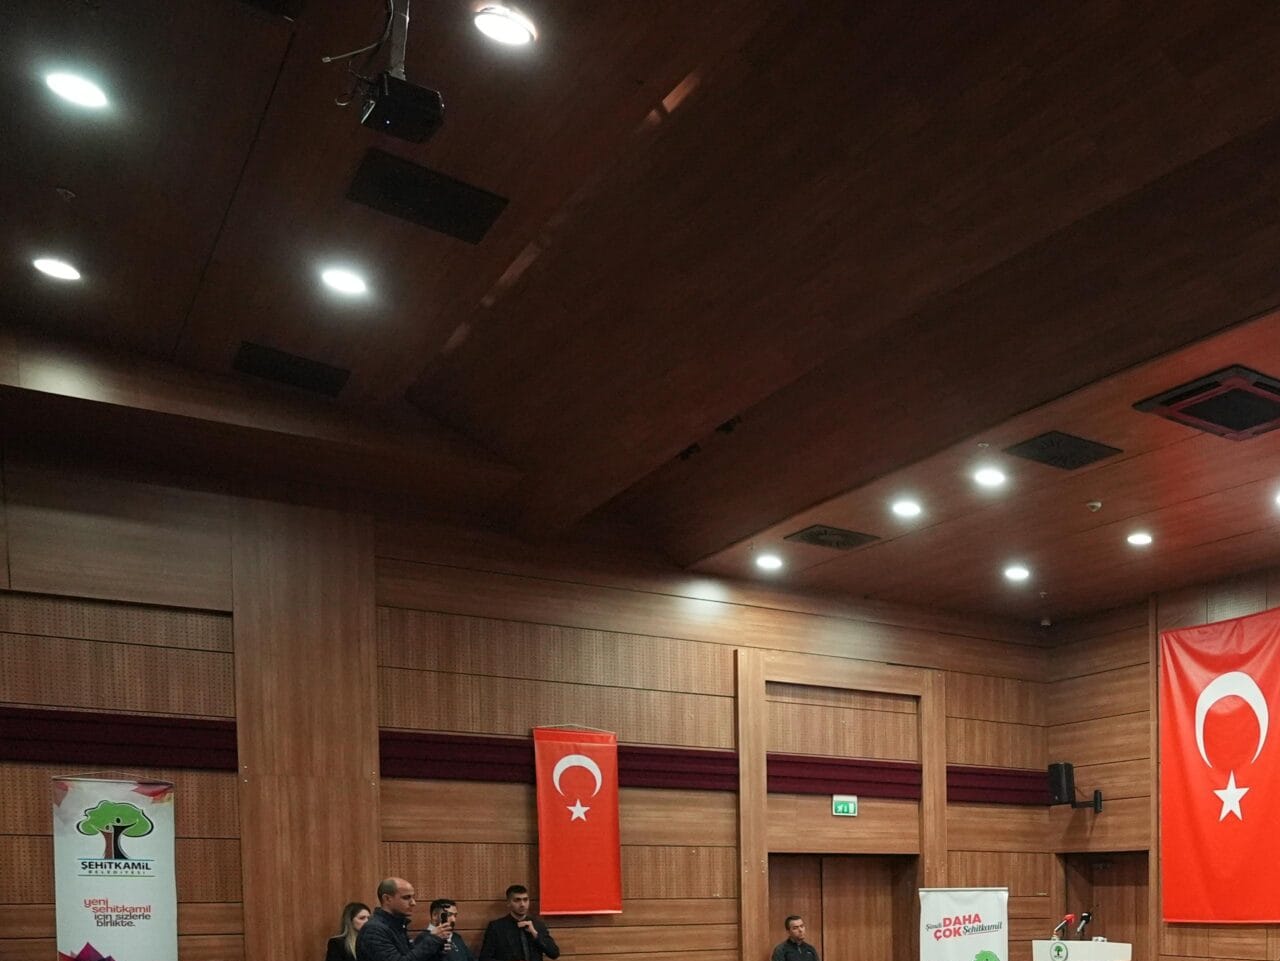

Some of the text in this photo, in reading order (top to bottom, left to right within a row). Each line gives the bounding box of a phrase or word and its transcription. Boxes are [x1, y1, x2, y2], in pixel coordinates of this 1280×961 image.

[83, 898, 109, 908] yeni
[943, 913, 982, 928] DAHA
[934, 927, 963, 941] ÇOK
